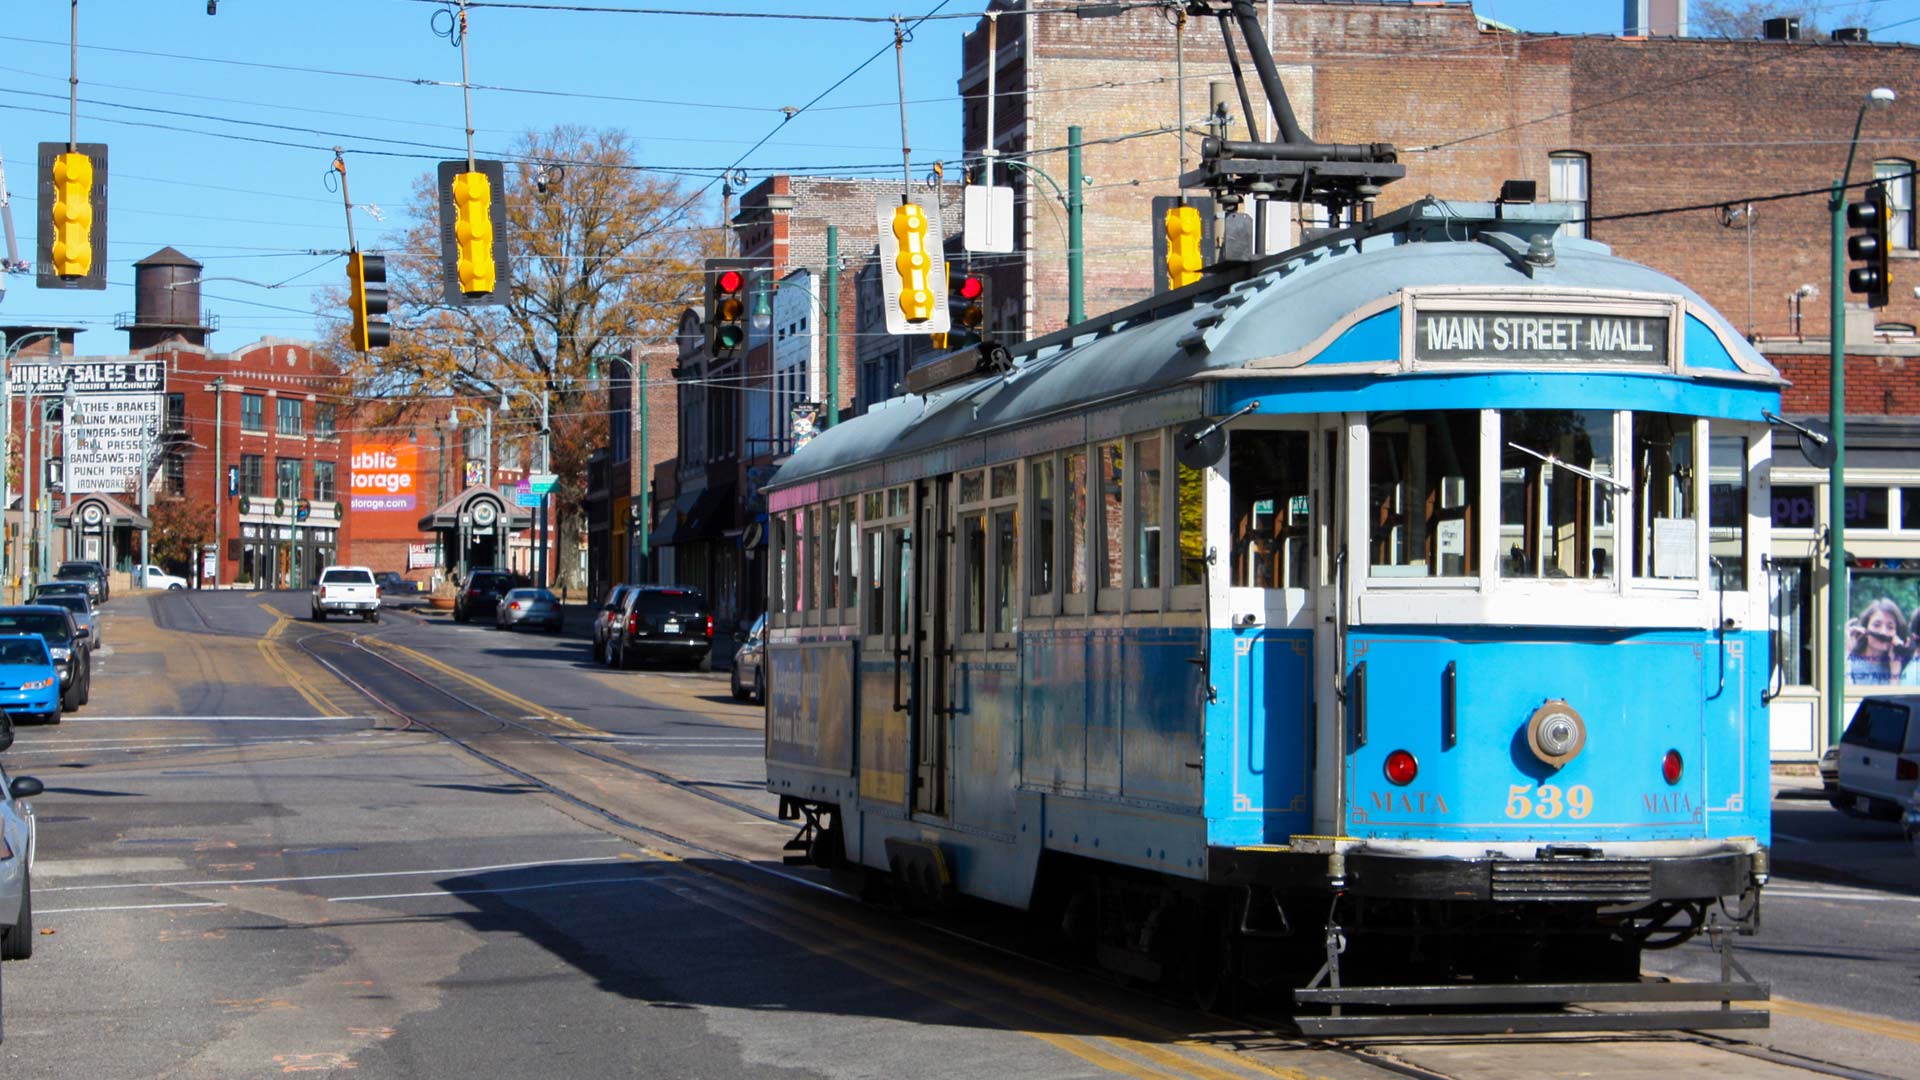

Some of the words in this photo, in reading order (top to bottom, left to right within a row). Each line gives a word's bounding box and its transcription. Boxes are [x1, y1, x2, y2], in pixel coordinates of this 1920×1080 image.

[1427, 317, 1484, 350] MAIN
[1493, 317, 1582, 350] STREET
[1590, 319, 1653, 351] MALL
[74, 365, 125, 383] SALES
[37, 383, 63, 391] METAL
[74, 382, 106, 390] ORKING
[109, 382, 159, 390] MACHINERY
[117, 402, 156, 411] BRAKES
[109, 415, 157, 424] MACHINES
[71, 453, 124, 463] BANDSAWS
[74, 466, 105, 475] PUNCH
[1369, 791, 1448, 813] MATA
[1505, 784, 1593, 819] 539
[1641, 792, 1692, 814] MATA
